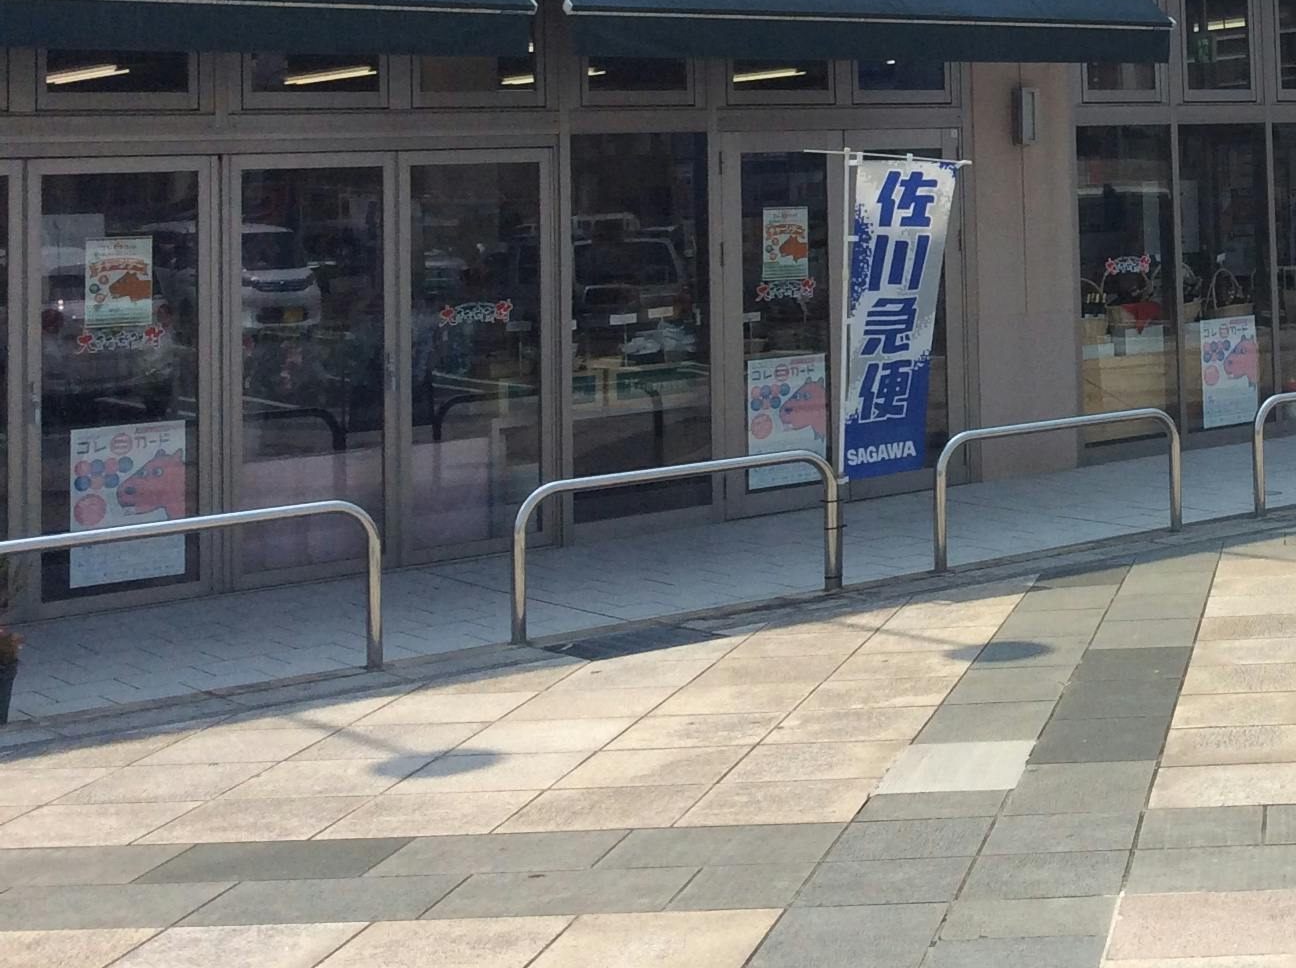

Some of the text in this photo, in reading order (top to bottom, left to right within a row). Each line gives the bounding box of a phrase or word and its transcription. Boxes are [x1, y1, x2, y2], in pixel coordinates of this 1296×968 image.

[857, 170, 938, 424] 佐川急便
[846, 440, 917, 466] SAGAWA
